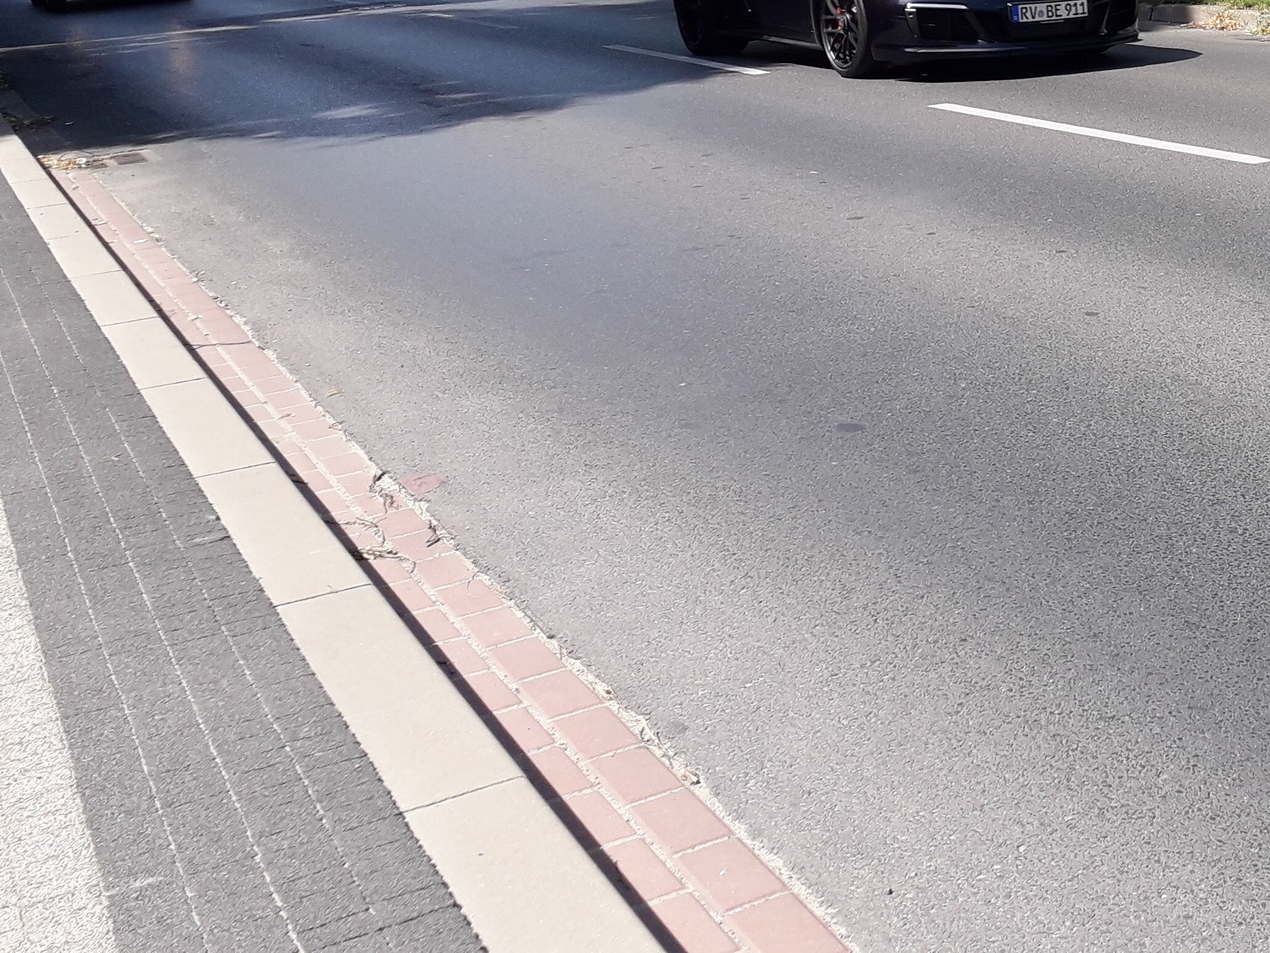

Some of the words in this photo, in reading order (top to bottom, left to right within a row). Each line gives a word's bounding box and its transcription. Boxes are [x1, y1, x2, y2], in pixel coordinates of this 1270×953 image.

[1020, 6, 1037, 21] RV
[1046, 4, 1063, 19] BE
[1064, 1, 1087, 17] 911
